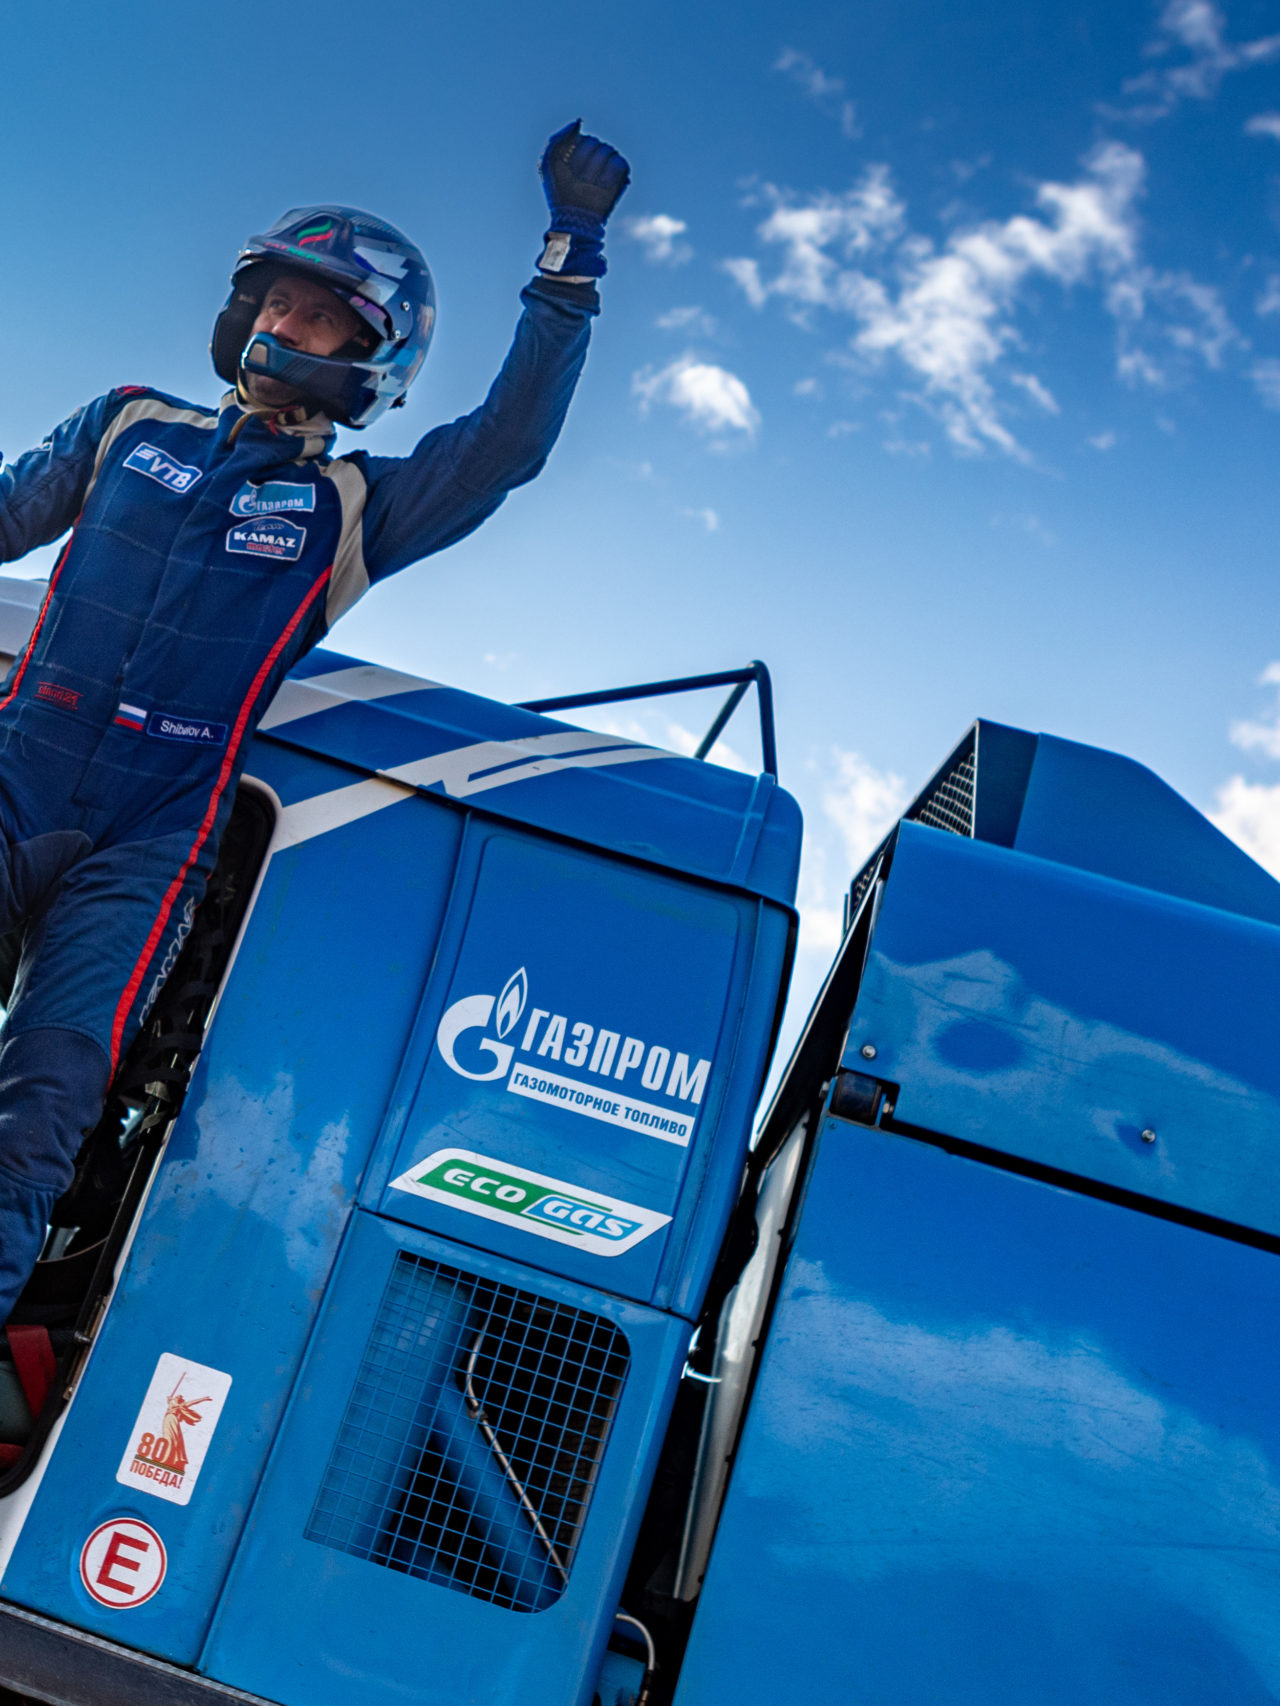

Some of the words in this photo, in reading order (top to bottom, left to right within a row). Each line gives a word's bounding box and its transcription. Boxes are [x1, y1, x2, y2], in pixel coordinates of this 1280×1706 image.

[150, 456, 191, 488] VTB
[257, 498, 304, 511] ГАЗПРОМ
[233, 531, 296, 548] KAMAZ
[201, 727, 214, 739] A.
[521, 1007, 711, 1105] ГАЗПРОМ
[513, 1073, 620, 1116] ГАЗОМОТОРНОЕ
[624, 1107, 688, 1137] ТОПЛИВО
[443, 1168, 527, 1203] ECO
[137, 1432, 169, 1463] 80
[129, 1459, 184, 1489] ПОБЕДА!
[96, 1531, 150, 1596] E
